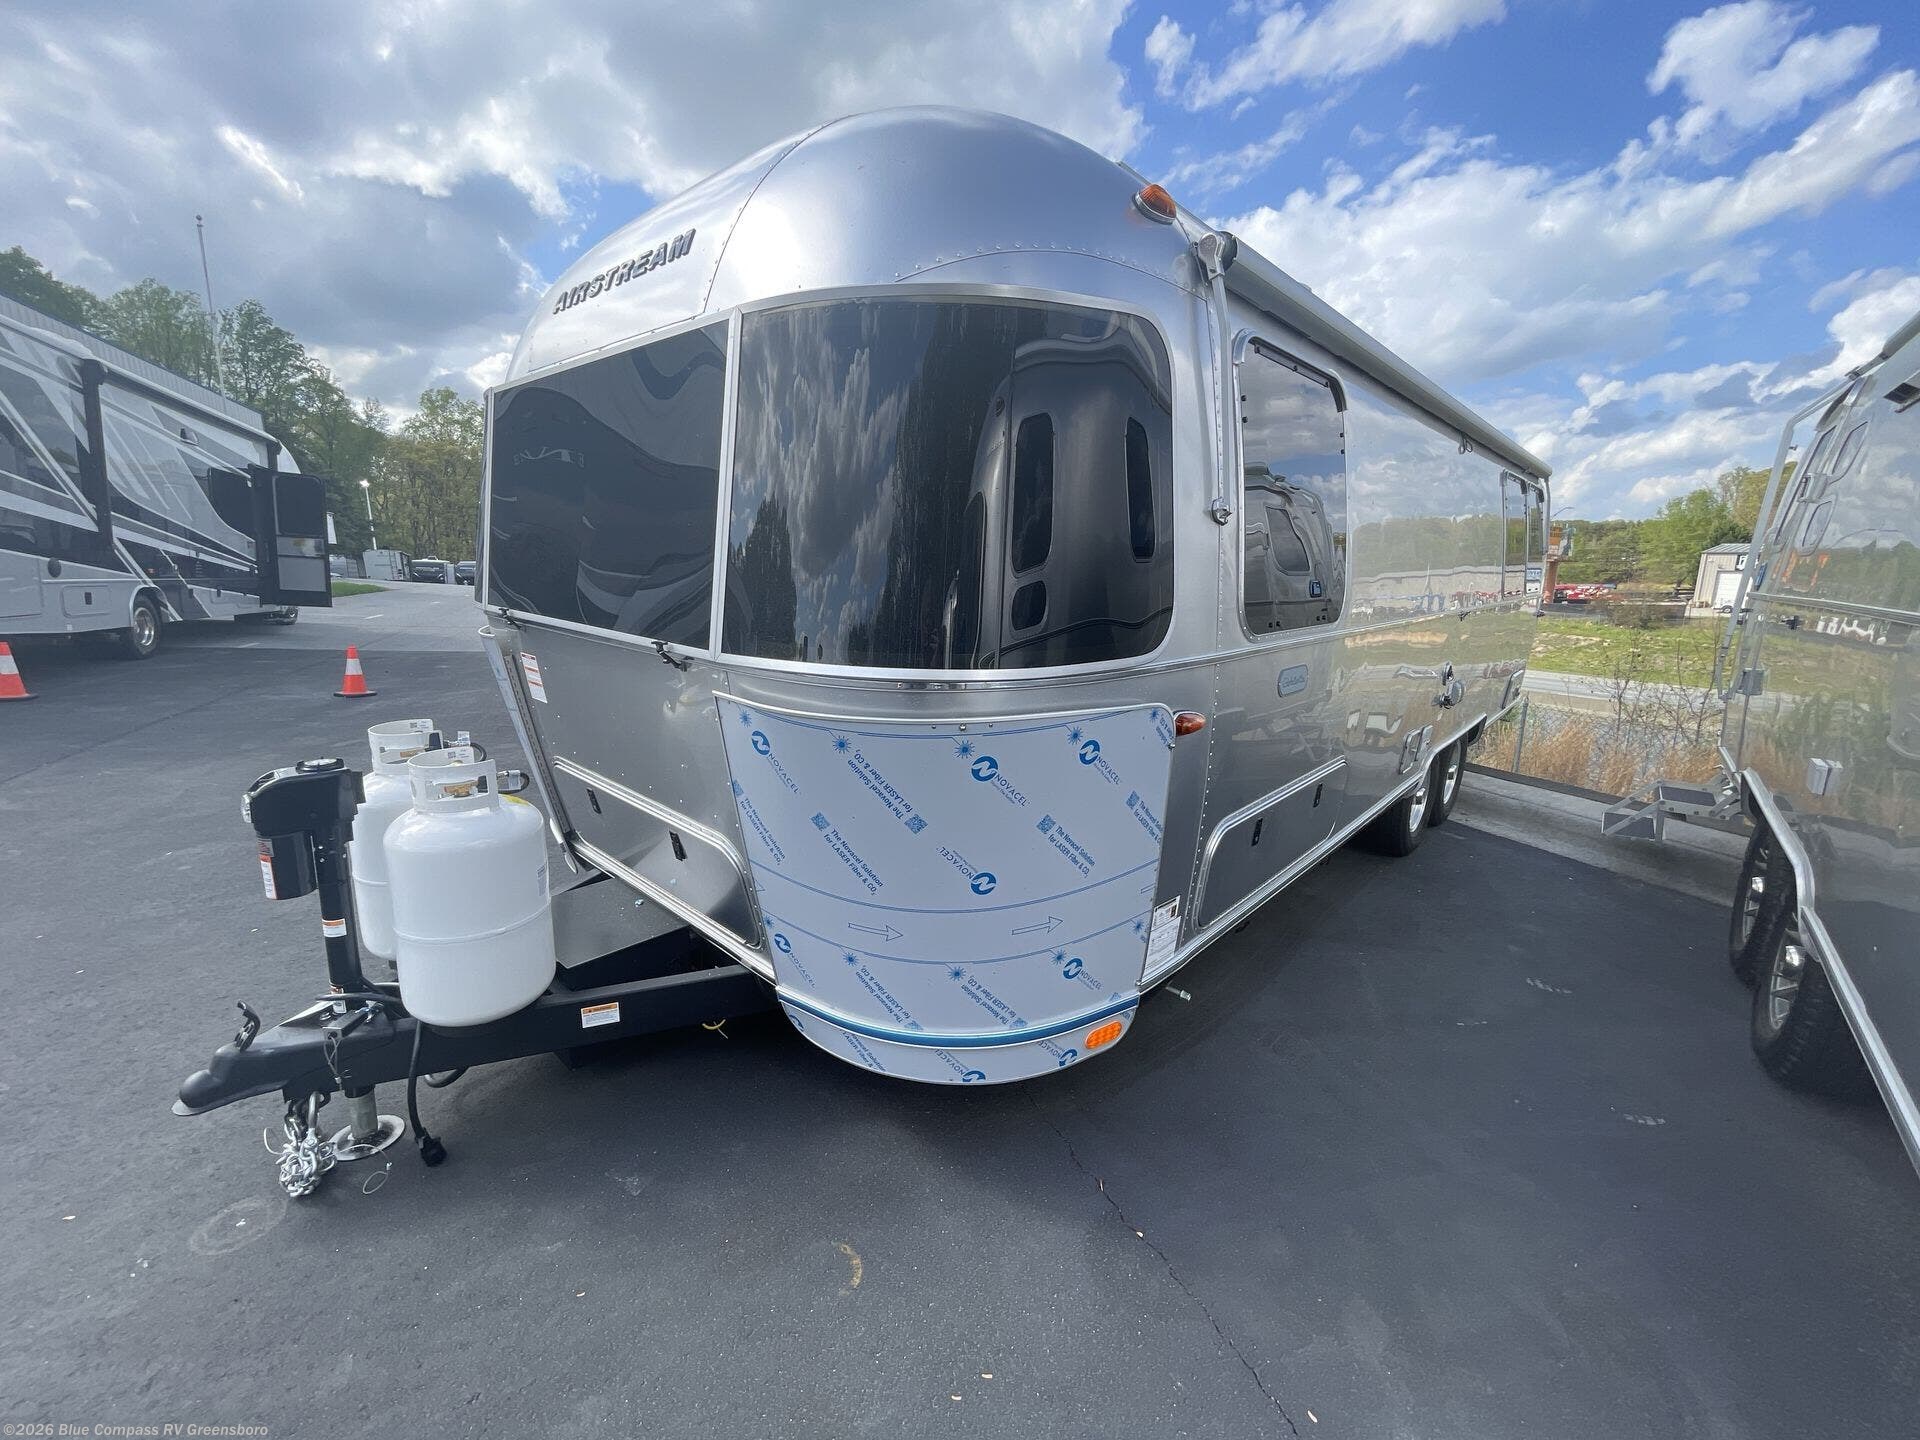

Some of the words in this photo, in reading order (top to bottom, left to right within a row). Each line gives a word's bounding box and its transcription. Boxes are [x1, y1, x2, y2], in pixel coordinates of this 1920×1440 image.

[552, 228, 696, 314] AIRSTREAM
[848, 760, 871, 785] Solution
[869, 769, 885, 785] Fiber
[1097, 757, 1120, 784] NOVACEL
[869, 784, 893, 808] Novacel
[883, 784, 904, 804] LASER
[995, 774, 1026, 806] NOVACEL
[893, 807, 904, 819] The
[903, 803, 913, 813] for
[824, 834, 833, 843] for
[832, 843, 850, 863] LASER
[849, 863, 863, 878] Fiber
[831, 829, 841, 840] The
[841, 841, 863, 864] Novacel
[861, 864, 883, 887] Solution
[940, 847, 973, 879] NOVACEL
